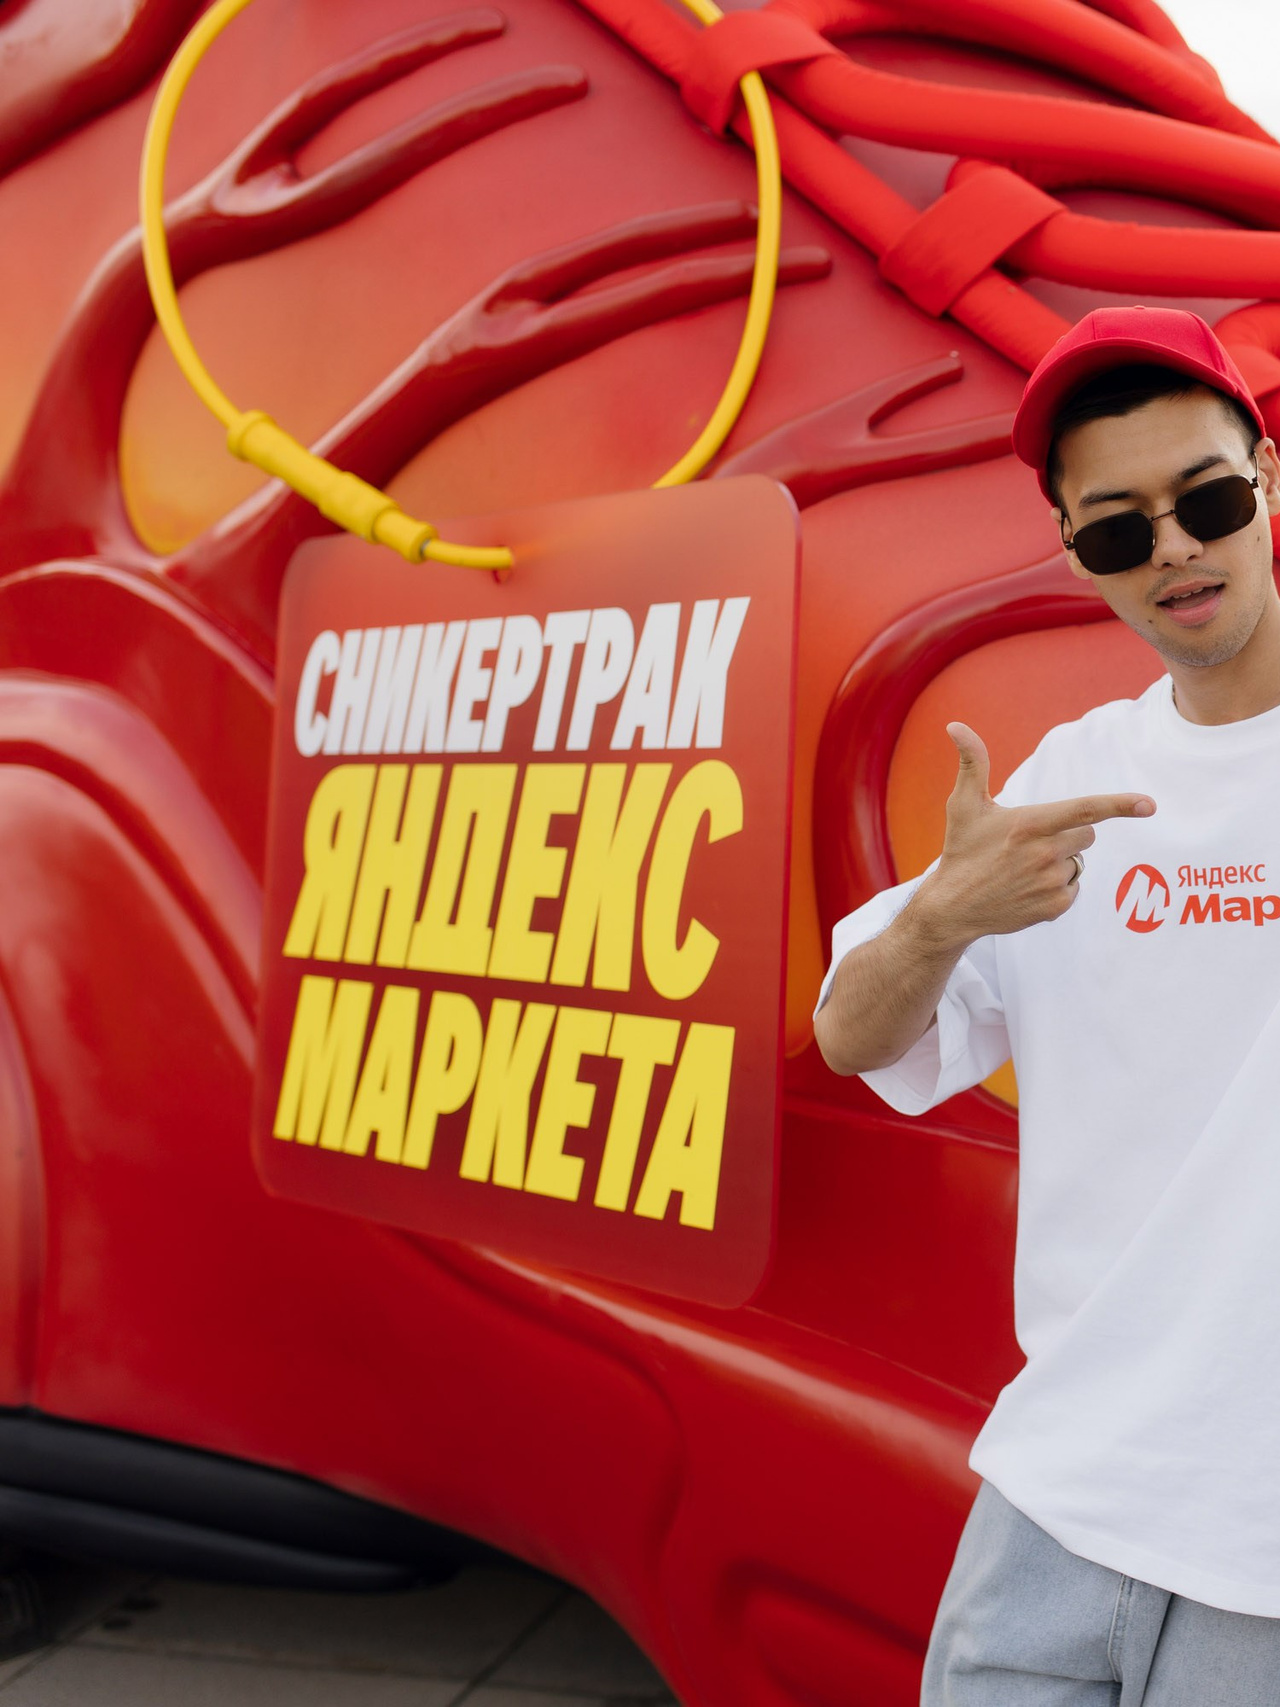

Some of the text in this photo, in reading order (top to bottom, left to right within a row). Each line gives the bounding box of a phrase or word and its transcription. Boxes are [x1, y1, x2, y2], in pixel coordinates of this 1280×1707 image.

[294, 596, 752, 757] СНИКЕРТРАК
[282, 759, 744, 1001] ЯНДЕКС
[1177, 863, 1266, 889] Яндекс
[272, 974, 736, 1231] МАРКЕТА
